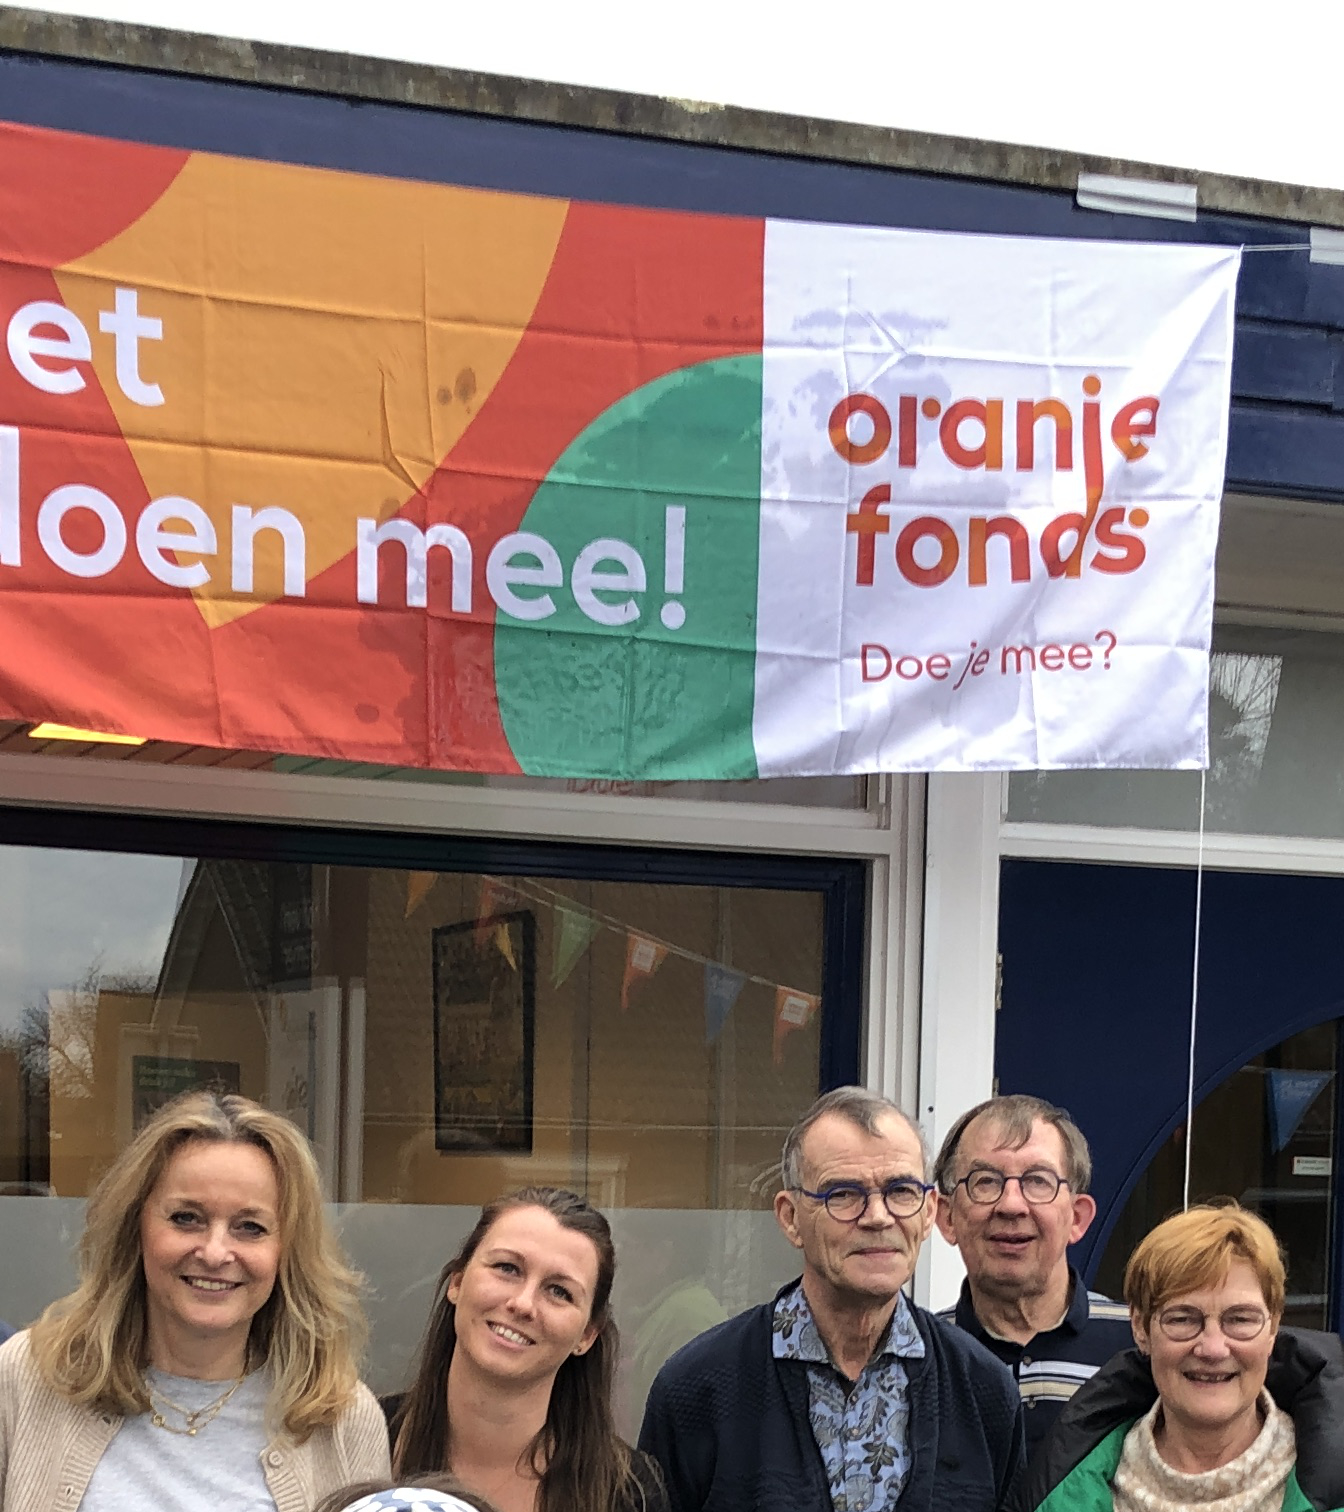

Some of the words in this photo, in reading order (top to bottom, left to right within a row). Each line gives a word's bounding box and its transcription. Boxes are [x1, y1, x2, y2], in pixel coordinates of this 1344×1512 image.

[828, 374, 1161, 500] oranje
[356, 504, 687, 631] mee!
[846, 483, 1150, 588] fonds
[860, 643, 951, 683] Doe
[953, 639, 989, 691] je
[1000, 630, 1118, 675] mee?
